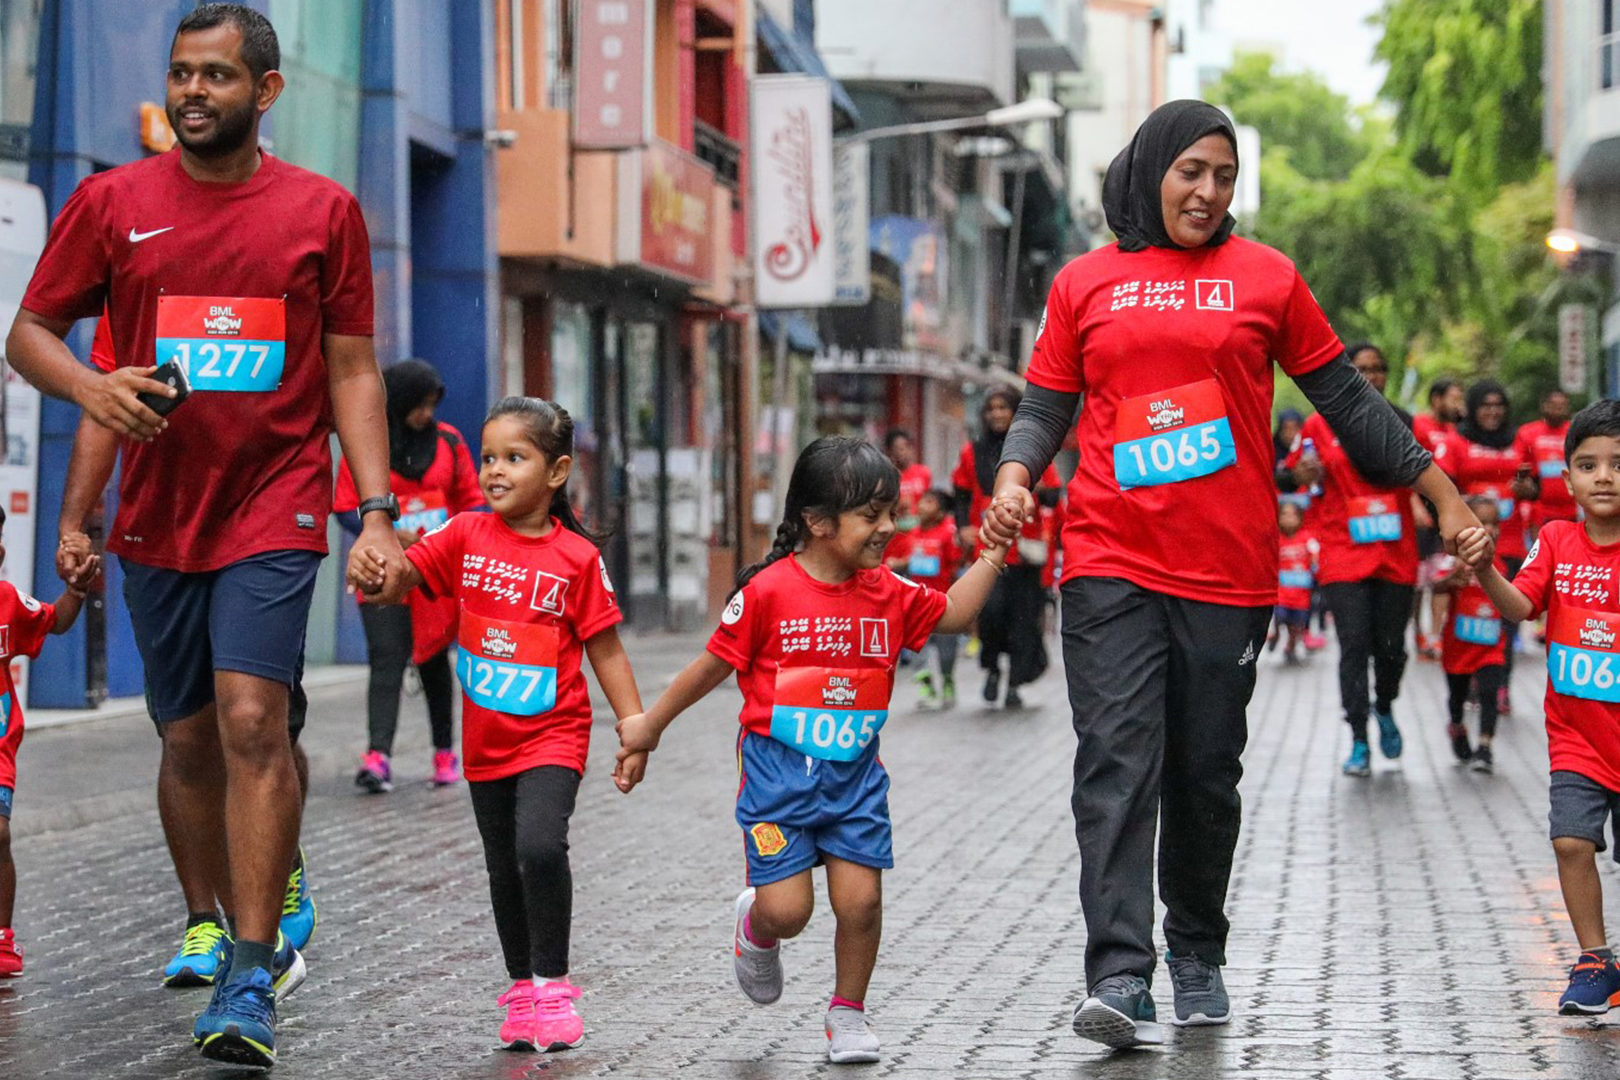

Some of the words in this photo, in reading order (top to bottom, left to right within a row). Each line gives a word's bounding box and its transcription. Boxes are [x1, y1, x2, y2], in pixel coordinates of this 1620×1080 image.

[210, 305, 236, 316] BML
[203, 316, 242, 330] WOW
[176, 343, 270, 379] 1277
[1150, 398, 1176, 412] BML
[1146, 406, 1184, 425] WOW
[1128, 425, 1221, 477] 1065
[1586, 618, 1610, 630] BML
[487, 627, 511, 641] BML
[1579, 628, 1616, 643] WOW
[481, 637, 517, 653] WOW
[1557, 649, 1620, 690] 106
[466, 656, 542, 703] 1277
[829, 676, 852, 687] BML
[822, 686, 857, 701] WOW
[793, 711, 877, 749] 1065
